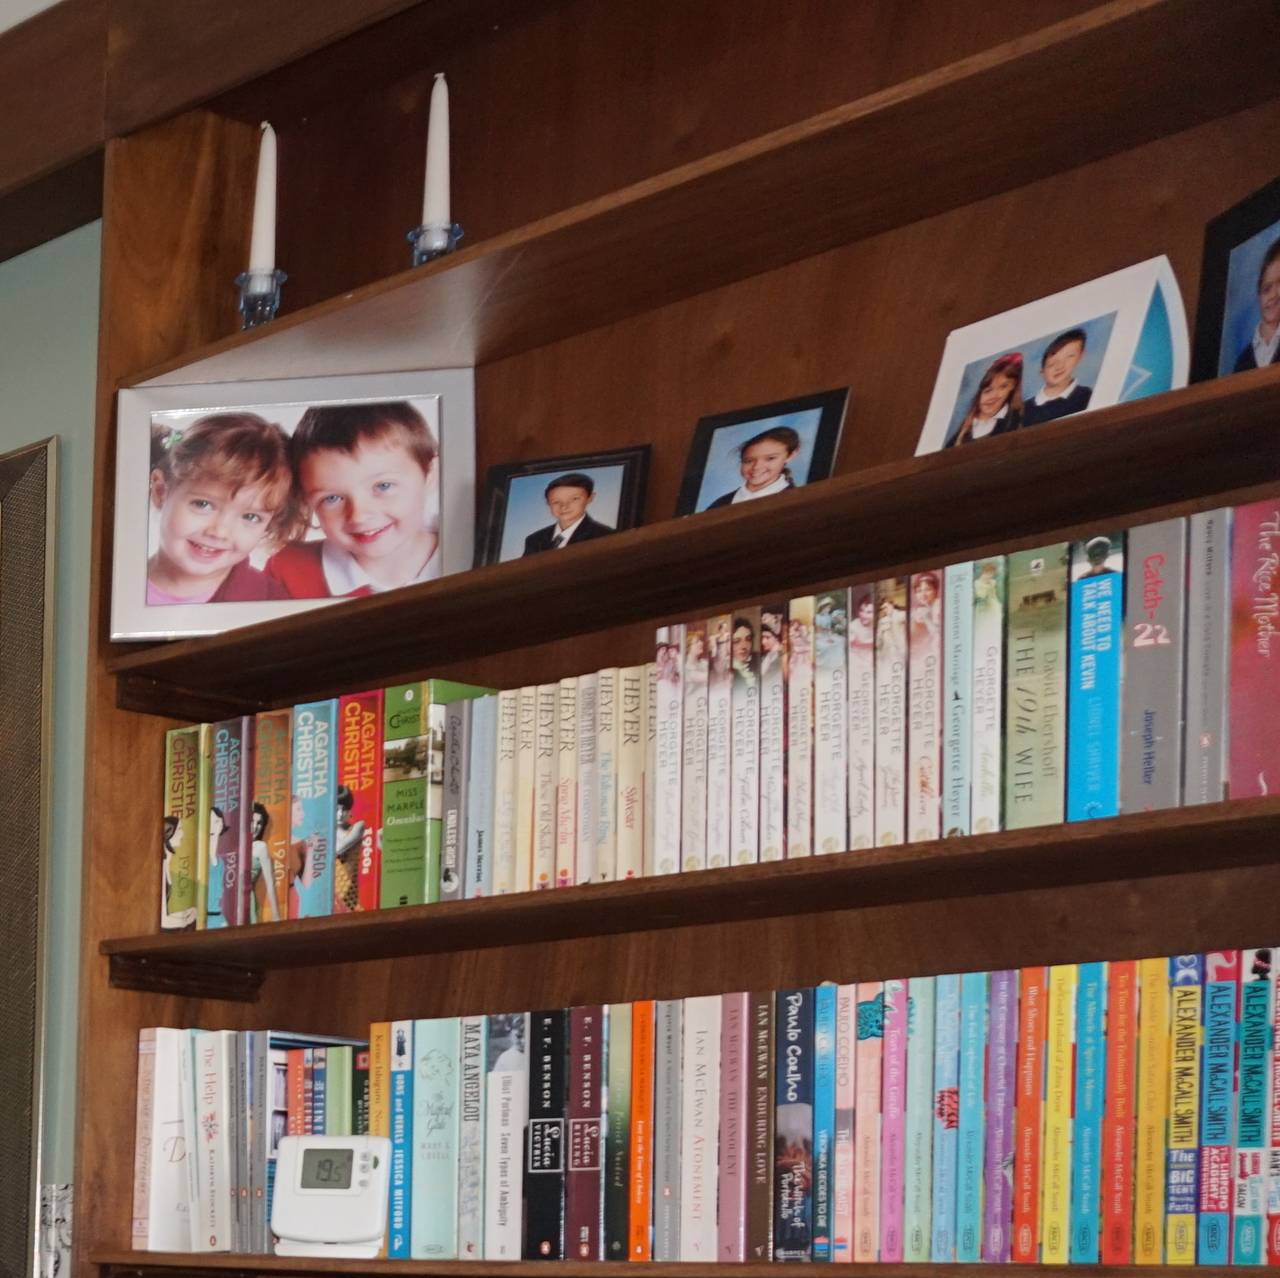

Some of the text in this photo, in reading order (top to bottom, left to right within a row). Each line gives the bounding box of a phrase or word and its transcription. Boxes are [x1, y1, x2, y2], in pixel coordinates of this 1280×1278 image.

[1096, 577, 1112, 652] WE NEED TO
[1143, 553, 1167, 621] Catch-
[1252, 511, 1280, 657] The Rice Mother
[1079, 581, 1097, 690] TALK ABOUT KEVIN
[1133, 622, 1171, 648] 22
[538, 693, 554, 760] HEYER
[559, 686, 576, 753] HEYER
[599, 676, 612, 733] HEYER
[623, 678, 640, 746] HEYER
[1014, 630, 1036, 805] THE WIFE
[1041, 651, 1059, 779] David Ebershoff
[172, 737, 185, 818] CHRISTIE
[185, 746, 197, 818] AGATHA
[228, 738, 241, 813] AGATHA
[258, 719, 273, 806] CHRISTIE
[273, 729, 288, 805] AGATHA
[297, 711, 313, 799] CHRISTIE
[313, 720, 329, 798] AGATHA
[343, 702, 361, 791] CHRISTIE
[360, 711, 376, 790] AGATHA
[949, 704, 965, 818] Georgette Heyer
[1142, 709, 1157, 786] Joseph Heller
[387, 800, 425, 813] MARPLE
[396, 787, 417, 798] MISS
[225, 851, 236, 889] 1930s
[274, 840, 286, 887] 1940s
[362, 827, 374, 875] 1960s
[463, 1023, 481, 1058] MAYA
[542, 1017, 553, 1110] E. BENSON
[582, 1016, 593, 1109] E. BENSON
[786, 992, 804, 1102] Paulo Coelho
[837, 996, 851, 1087] PAULO COELHO
[889, 1027, 901, 1051] Tears
[1173, 989, 1198, 1143] ALEXANDER McCALL SMITH
[1207, 985, 1233, 1140] ALEXANDER McCALL SMITH
[1241, 985, 1267, 1142] ALEXANDER McCALL SMITH
[203, 1072, 217, 1105] Help
[463, 1063, 481, 1123] ANGELOU
[727, 1009, 740, 1178] IAN THE INNOCENT
[755, 1004, 769, 1185] IAN ENDURING LOVE
[393, 1114, 406, 1230] REBELS JESSICA MITFORD
[542, 1124, 560, 1169] Lucia
[572, 1124, 582, 1167] RISING
[582, 1124, 600, 1168] Lucia
[817, 1129, 829, 1229] VERONIKA DECIDES TO DIE
[1169, 1150, 1195, 1162] The
[1169, 1169, 1195, 1184] BIG
[780, 1172, 794, 1219] Portobello
[792, 1161, 806, 1229] The of
[1168, 1184, 1195, 1194] TENT
